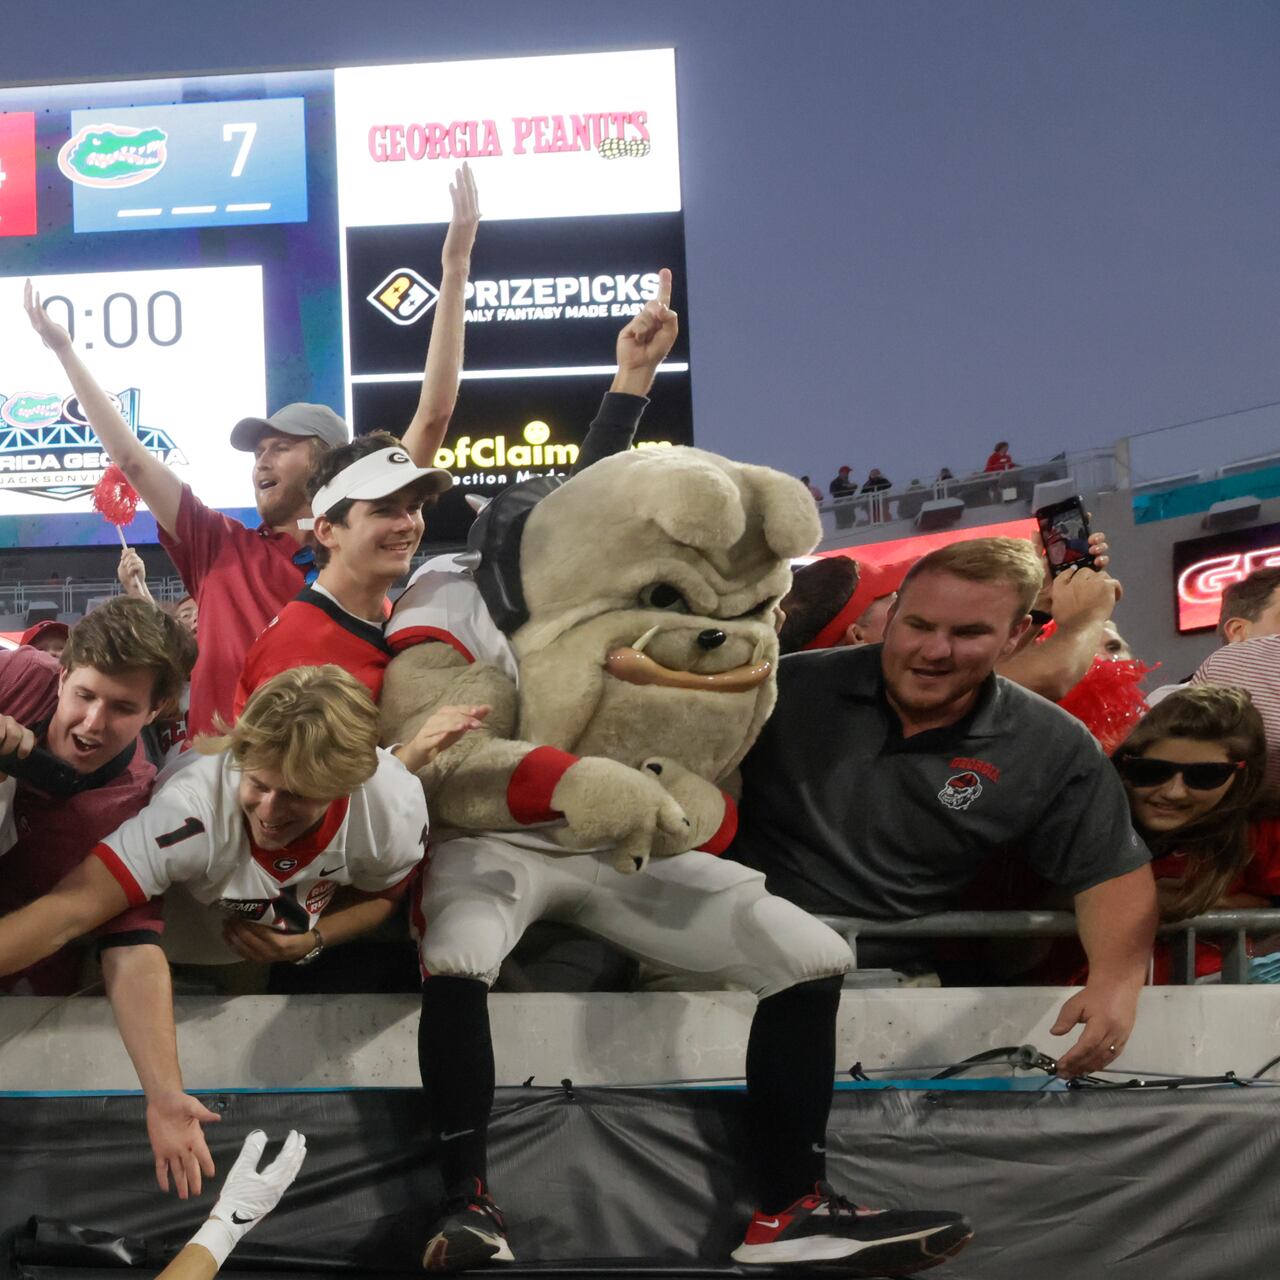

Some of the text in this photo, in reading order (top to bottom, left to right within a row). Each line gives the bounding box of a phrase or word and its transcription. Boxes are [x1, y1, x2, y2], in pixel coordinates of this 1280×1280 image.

[222, 123, 258, 178] 7
[368, 110, 650, 163] GEORGIA PEANUTS
[463, 272, 662, 308] PRIZEPICKS
[463, 308, 494, 323] AILY
[496, 306, 563, 321] FANTASY
[565, 304, 608, 318] MADE
